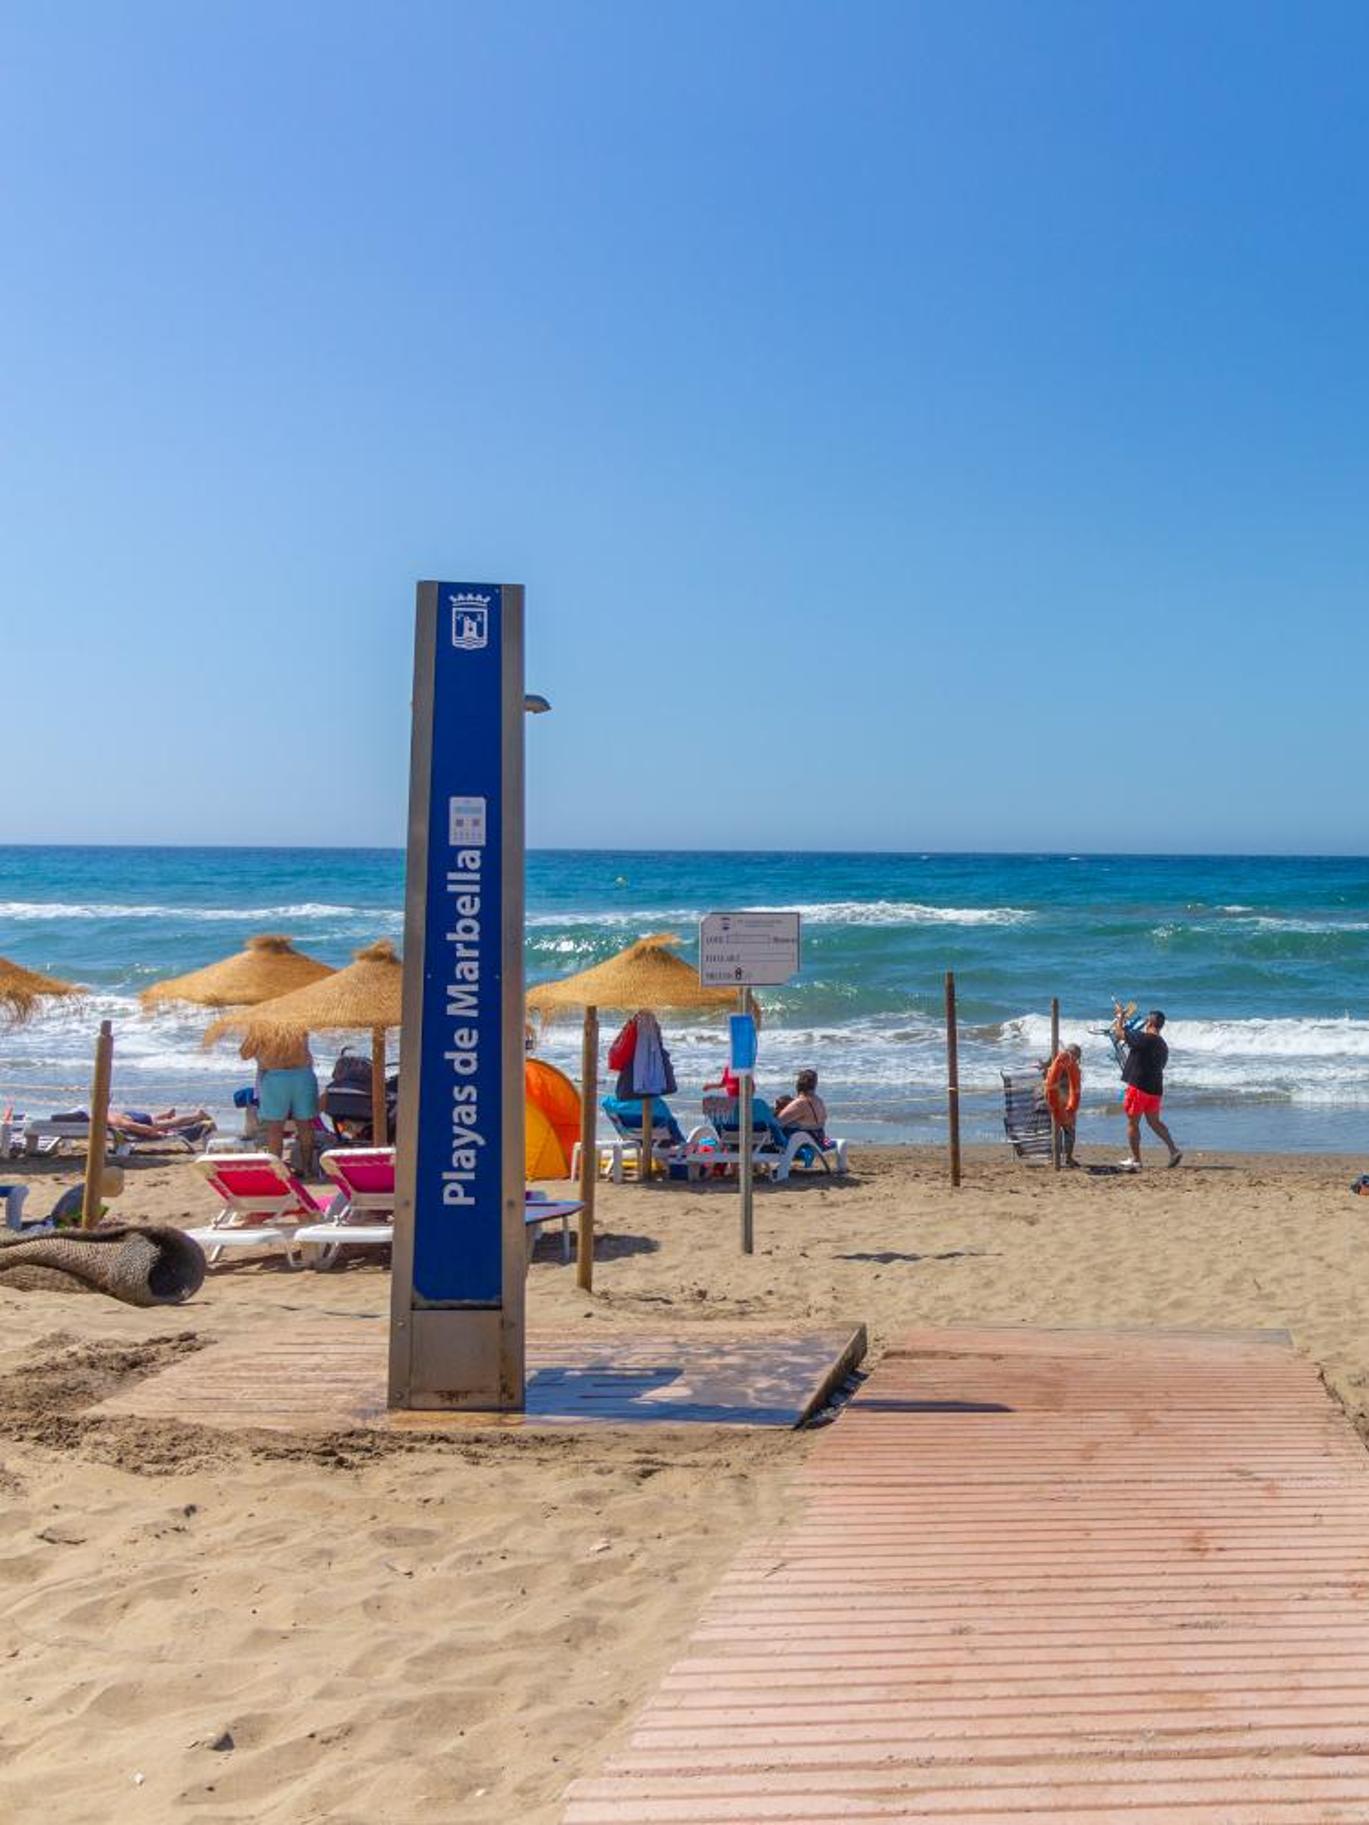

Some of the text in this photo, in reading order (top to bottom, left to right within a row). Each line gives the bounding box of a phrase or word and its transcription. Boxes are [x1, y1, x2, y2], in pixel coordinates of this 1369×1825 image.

[442, 849, 484, 1205] Playas de Marbella
